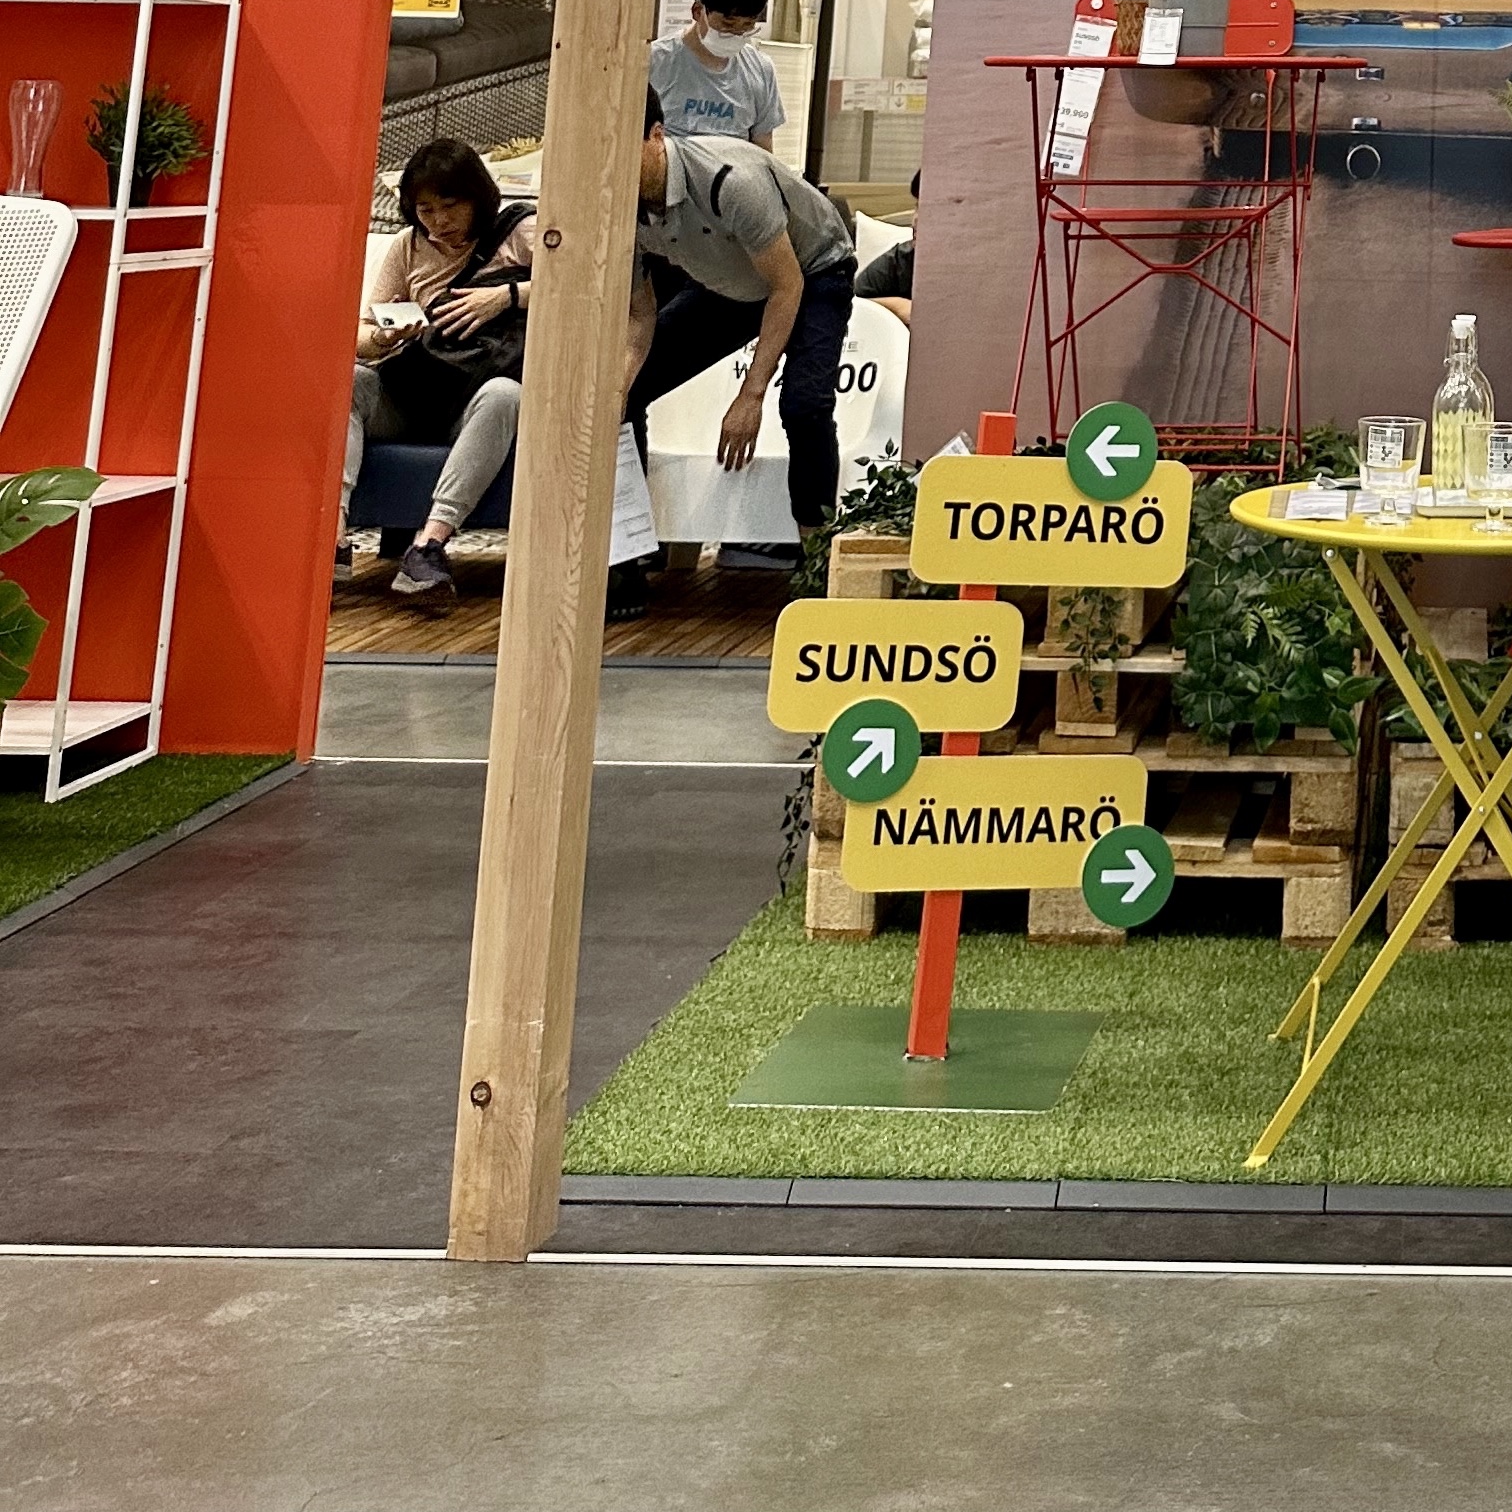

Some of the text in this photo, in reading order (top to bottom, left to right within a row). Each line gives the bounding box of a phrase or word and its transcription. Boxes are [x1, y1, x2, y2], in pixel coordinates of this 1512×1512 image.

[684, 97, 735, 119] PUMA
[944, 496, 1165, 545] TORPARÖ
[796, 634, 998, 684] SUNDSÖ
[873, 795, 1122, 846] NÄMMARÖ
